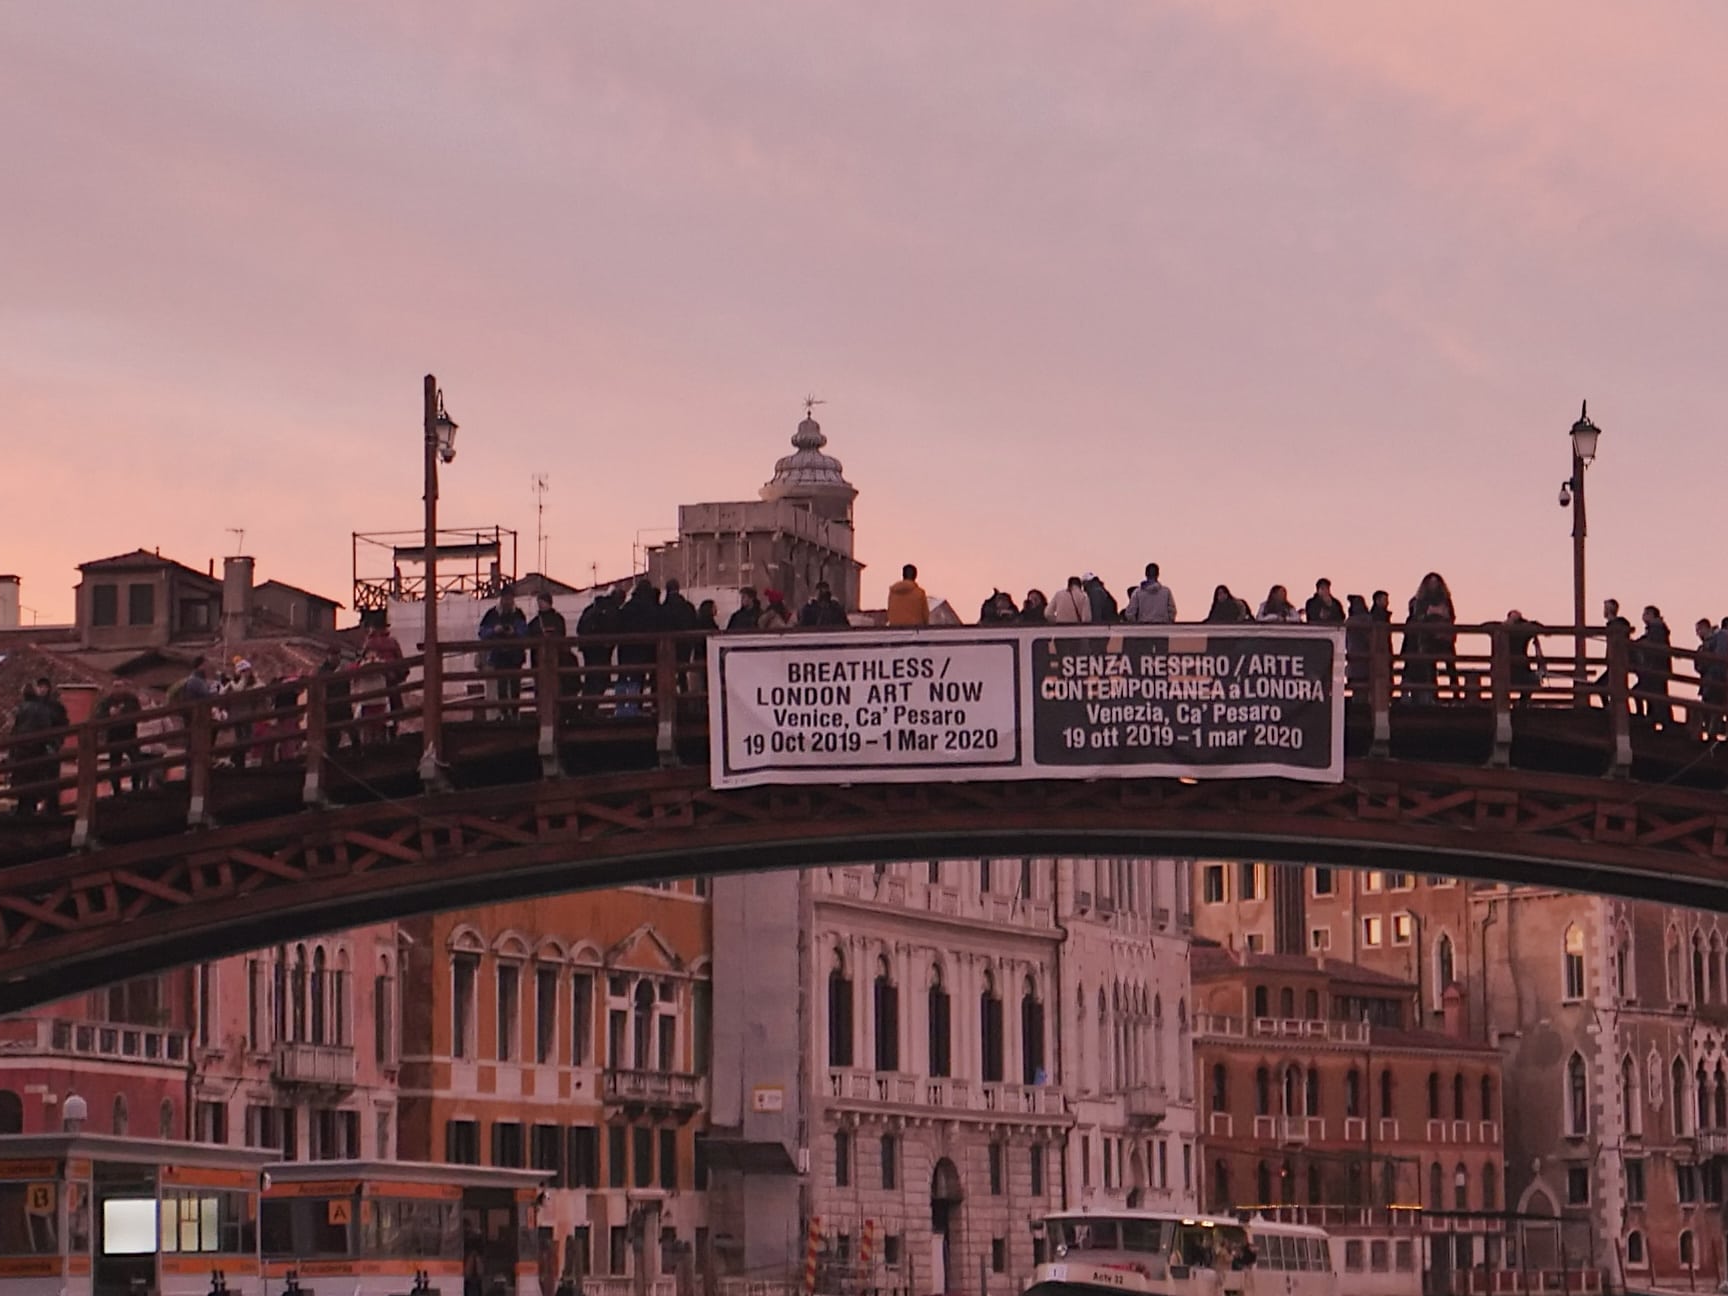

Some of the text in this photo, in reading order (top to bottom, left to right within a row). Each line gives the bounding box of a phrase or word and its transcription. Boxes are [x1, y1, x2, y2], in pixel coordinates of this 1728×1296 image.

[788, 657, 951, 683] BREATHLESS /
[1062, 655, 1304, 677] SENZA RESPIRO / ARTE
[756, 682, 984, 706] LONDON ART NOW
[1041, 677, 1225, 700] CONTEMPORANEA
[1244, 679, 1324, 702] LONDRA
[774, 708, 849, 729] Venice,
[894, 705, 966, 725] Pesaro
[1086, 704, 1170, 725] Venezia,
[1213, 704, 1281, 723] Pesaro
[743, 734, 765, 755] 19
[772, 731, 805, 752] Oct
[811, 731, 861, 753] 2019
[883, 730, 891, 751] 1
[898, 730, 938, 751] Mar
[945, 729, 998, 750] 2020
[1062, 728, 1085, 749] 19
[1091, 727, 1119, 748] ott
[1126, 724, 1173, 747] 2019
[1192, 727, 1202, 748] 1
[1208, 727, 1247, 747] mar
[1254, 726, 1302, 749] 2020
[34, 1187, 49, 1209] B
[333, 1205, 347, 1221] A
